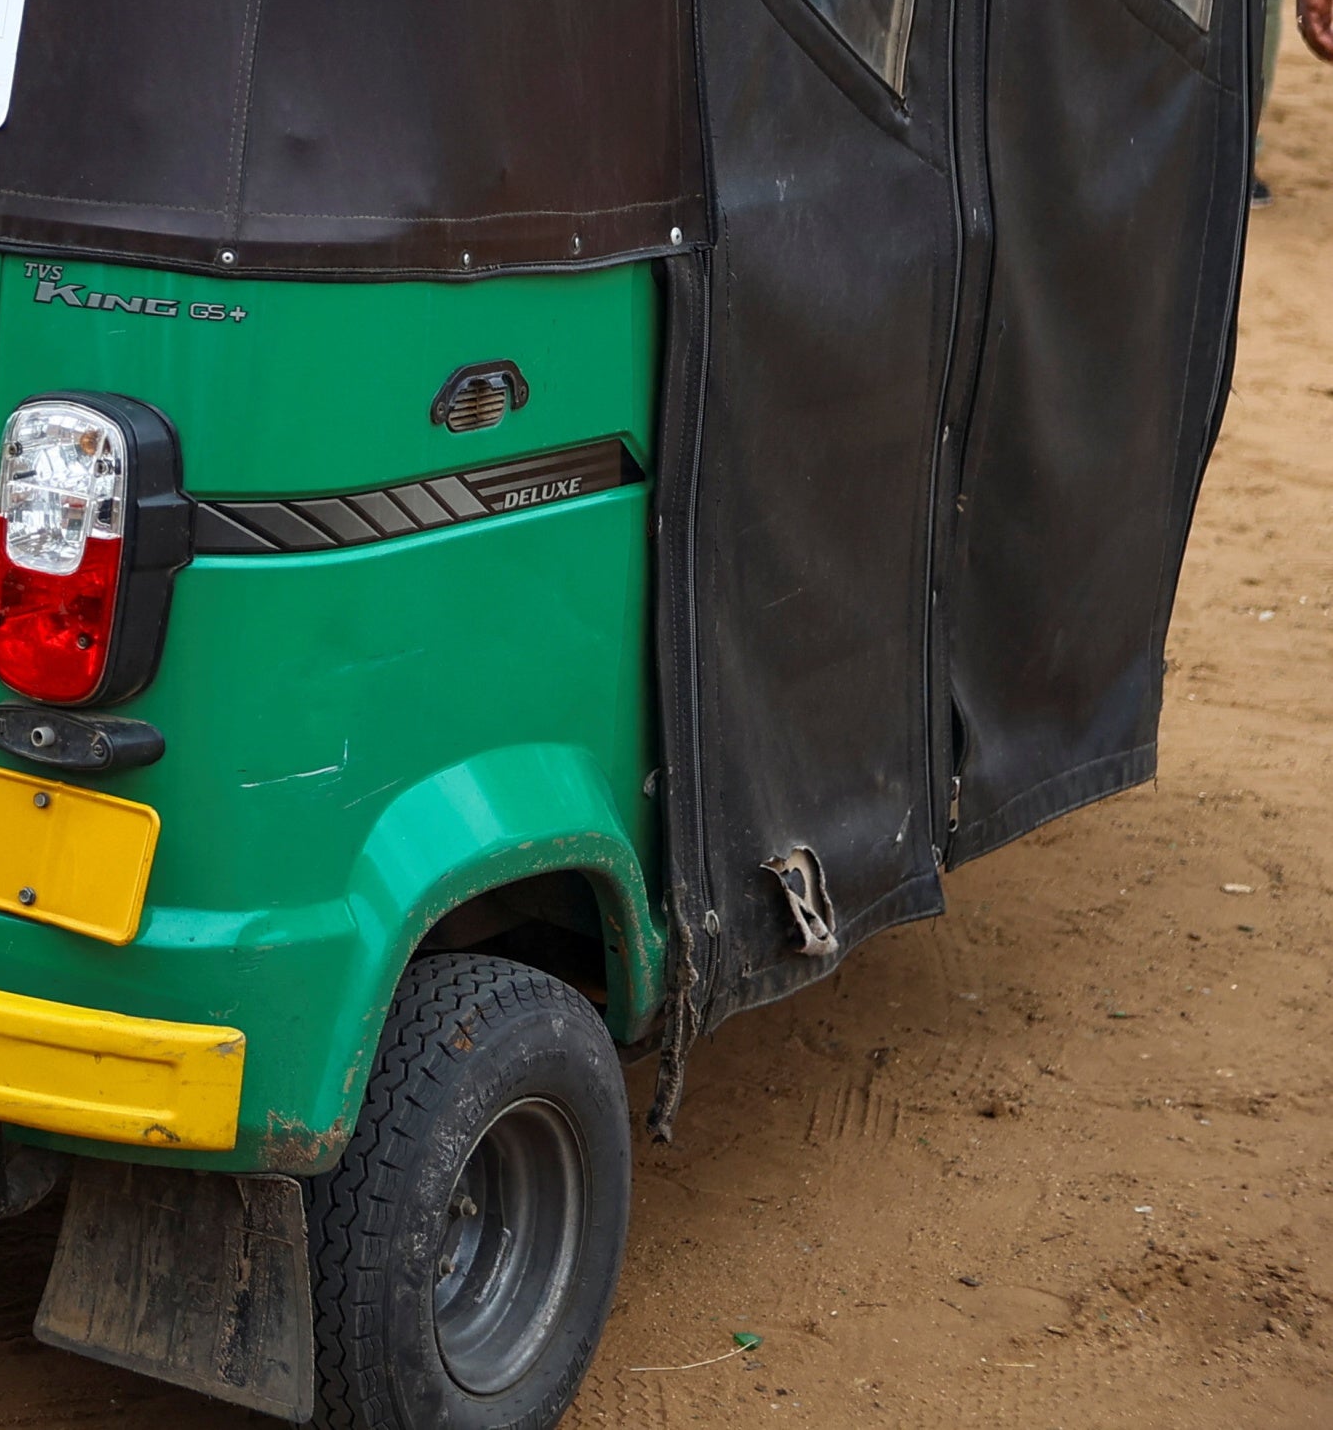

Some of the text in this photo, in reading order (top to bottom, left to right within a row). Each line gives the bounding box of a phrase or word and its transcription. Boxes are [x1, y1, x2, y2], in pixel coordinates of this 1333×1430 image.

[24, 262, 63, 281] TVS
[189, 302, 247, 322] GS+
[504, 476, 582, 509] DELUXE
